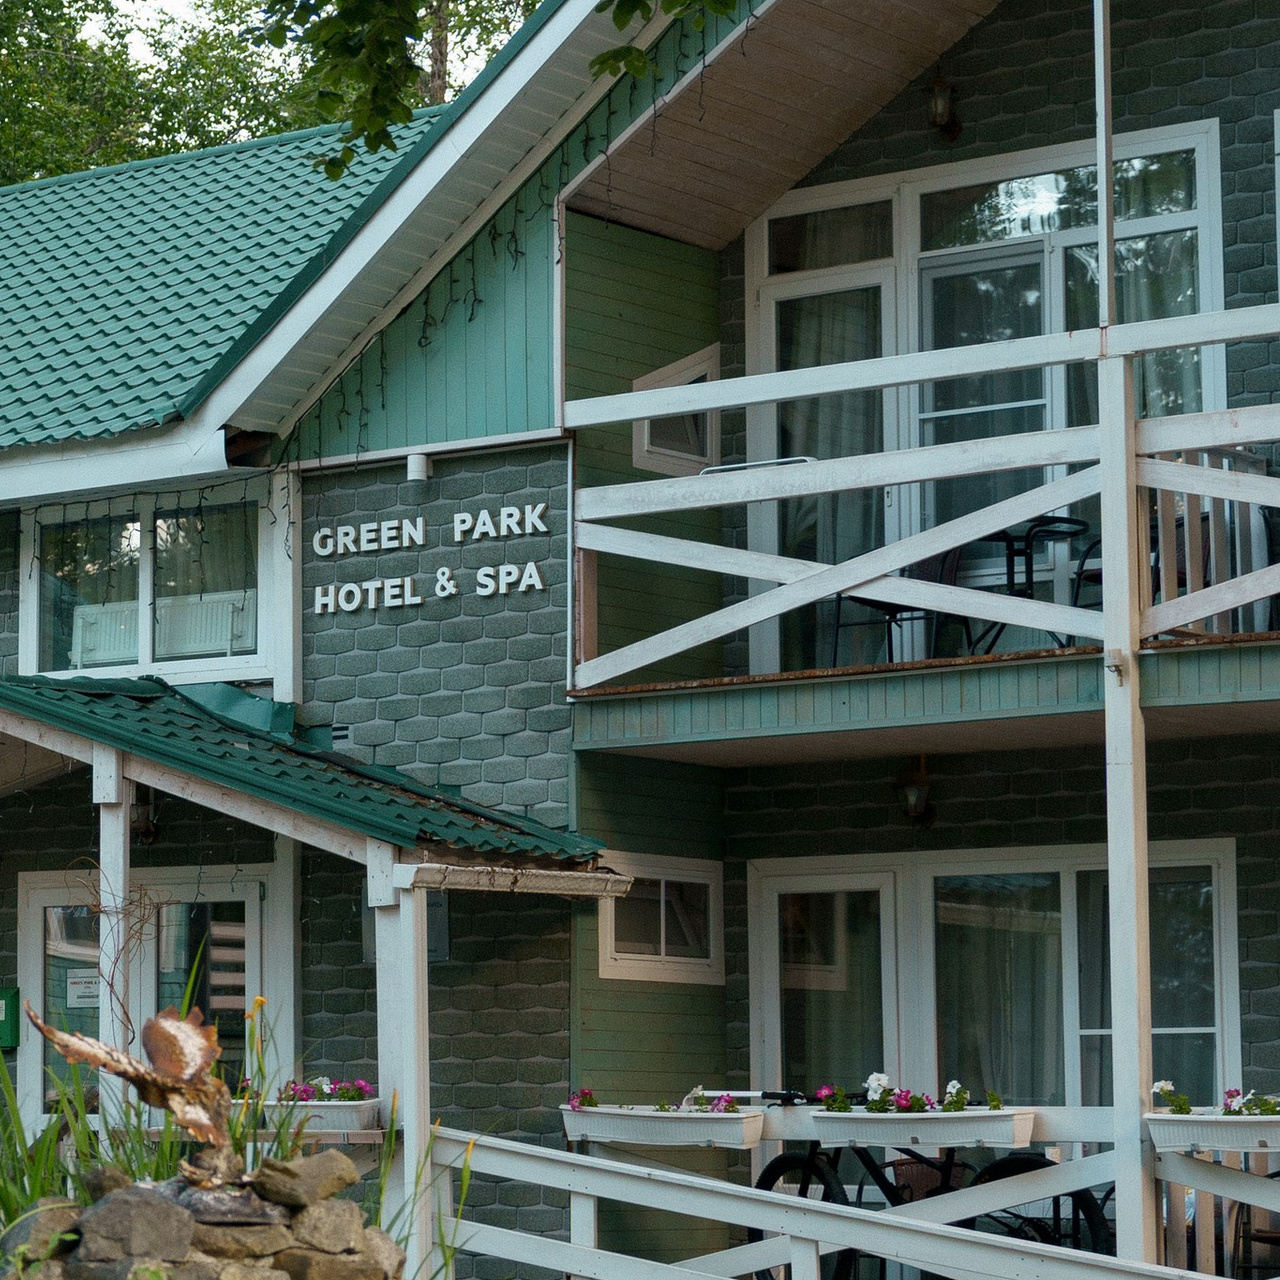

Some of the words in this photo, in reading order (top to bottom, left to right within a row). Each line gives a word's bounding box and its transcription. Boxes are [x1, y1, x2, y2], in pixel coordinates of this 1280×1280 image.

[312, 517, 426, 557] GREEN
[453, 503, 549, 542] PARK
[314, 577, 424, 614] HOTEL
[434, 566, 459, 598] &
[476, 561, 546, 597] SPA
